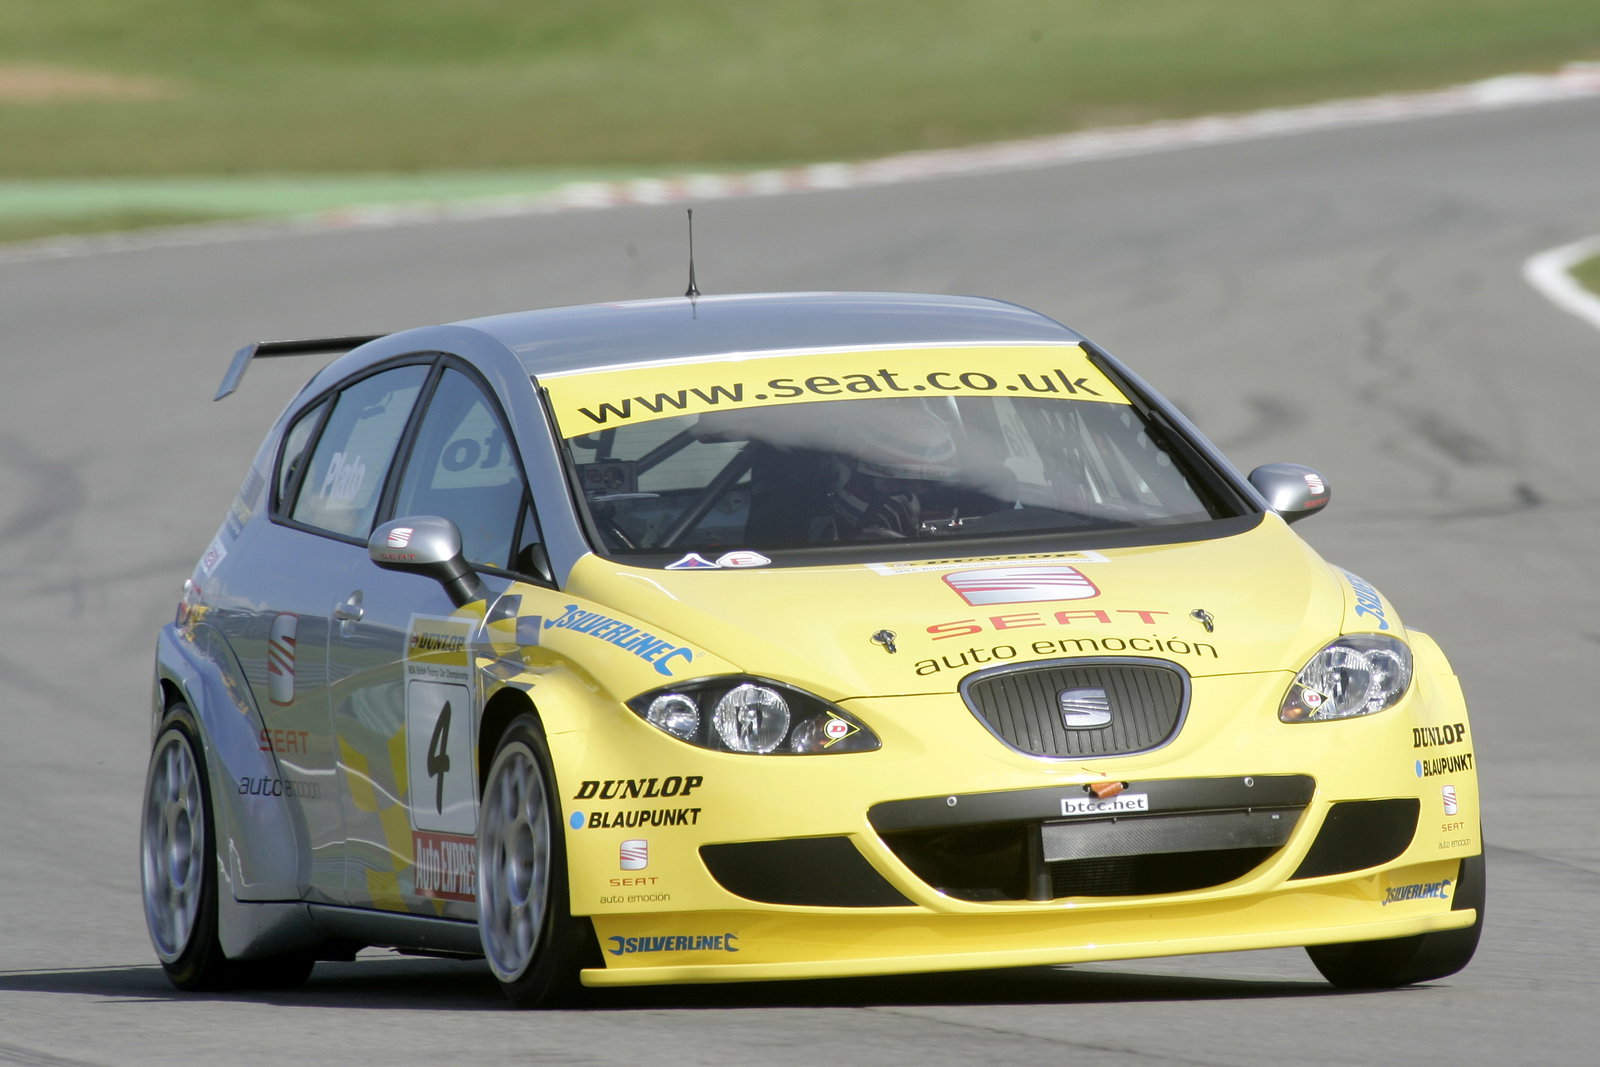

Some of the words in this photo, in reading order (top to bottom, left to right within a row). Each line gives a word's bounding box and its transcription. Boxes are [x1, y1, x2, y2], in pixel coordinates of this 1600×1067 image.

[578, 369, 1102, 424] www.seat.co.uk
[380, 552, 416, 561] SEAT
[927, 610, 1169, 640] SEAT
[419, 632, 466, 652] DUNLOP
[914, 645, 1017, 676] auto
[1032, 634, 1219, 659] emoción
[258, 728, 309, 754] SEAT
[1412, 723, 1465, 748] DUNLOP
[427, 700, 451, 815] 4
[1423, 754, 1473, 777] BLAUPUNKT
[238, 776, 283, 796] auto
[573, 776, 703, 800] DUNLOP
[1065, 798, 1144, 813] btcc.net
[588, 808, 702, 829] BLAUPUNKT
[1441, 822, 1464, 832] SEAT
[416, 838, 440, 891] Auto
[609, 877, 659, 887] SEAT
[600, 894, 625, 904] auto
